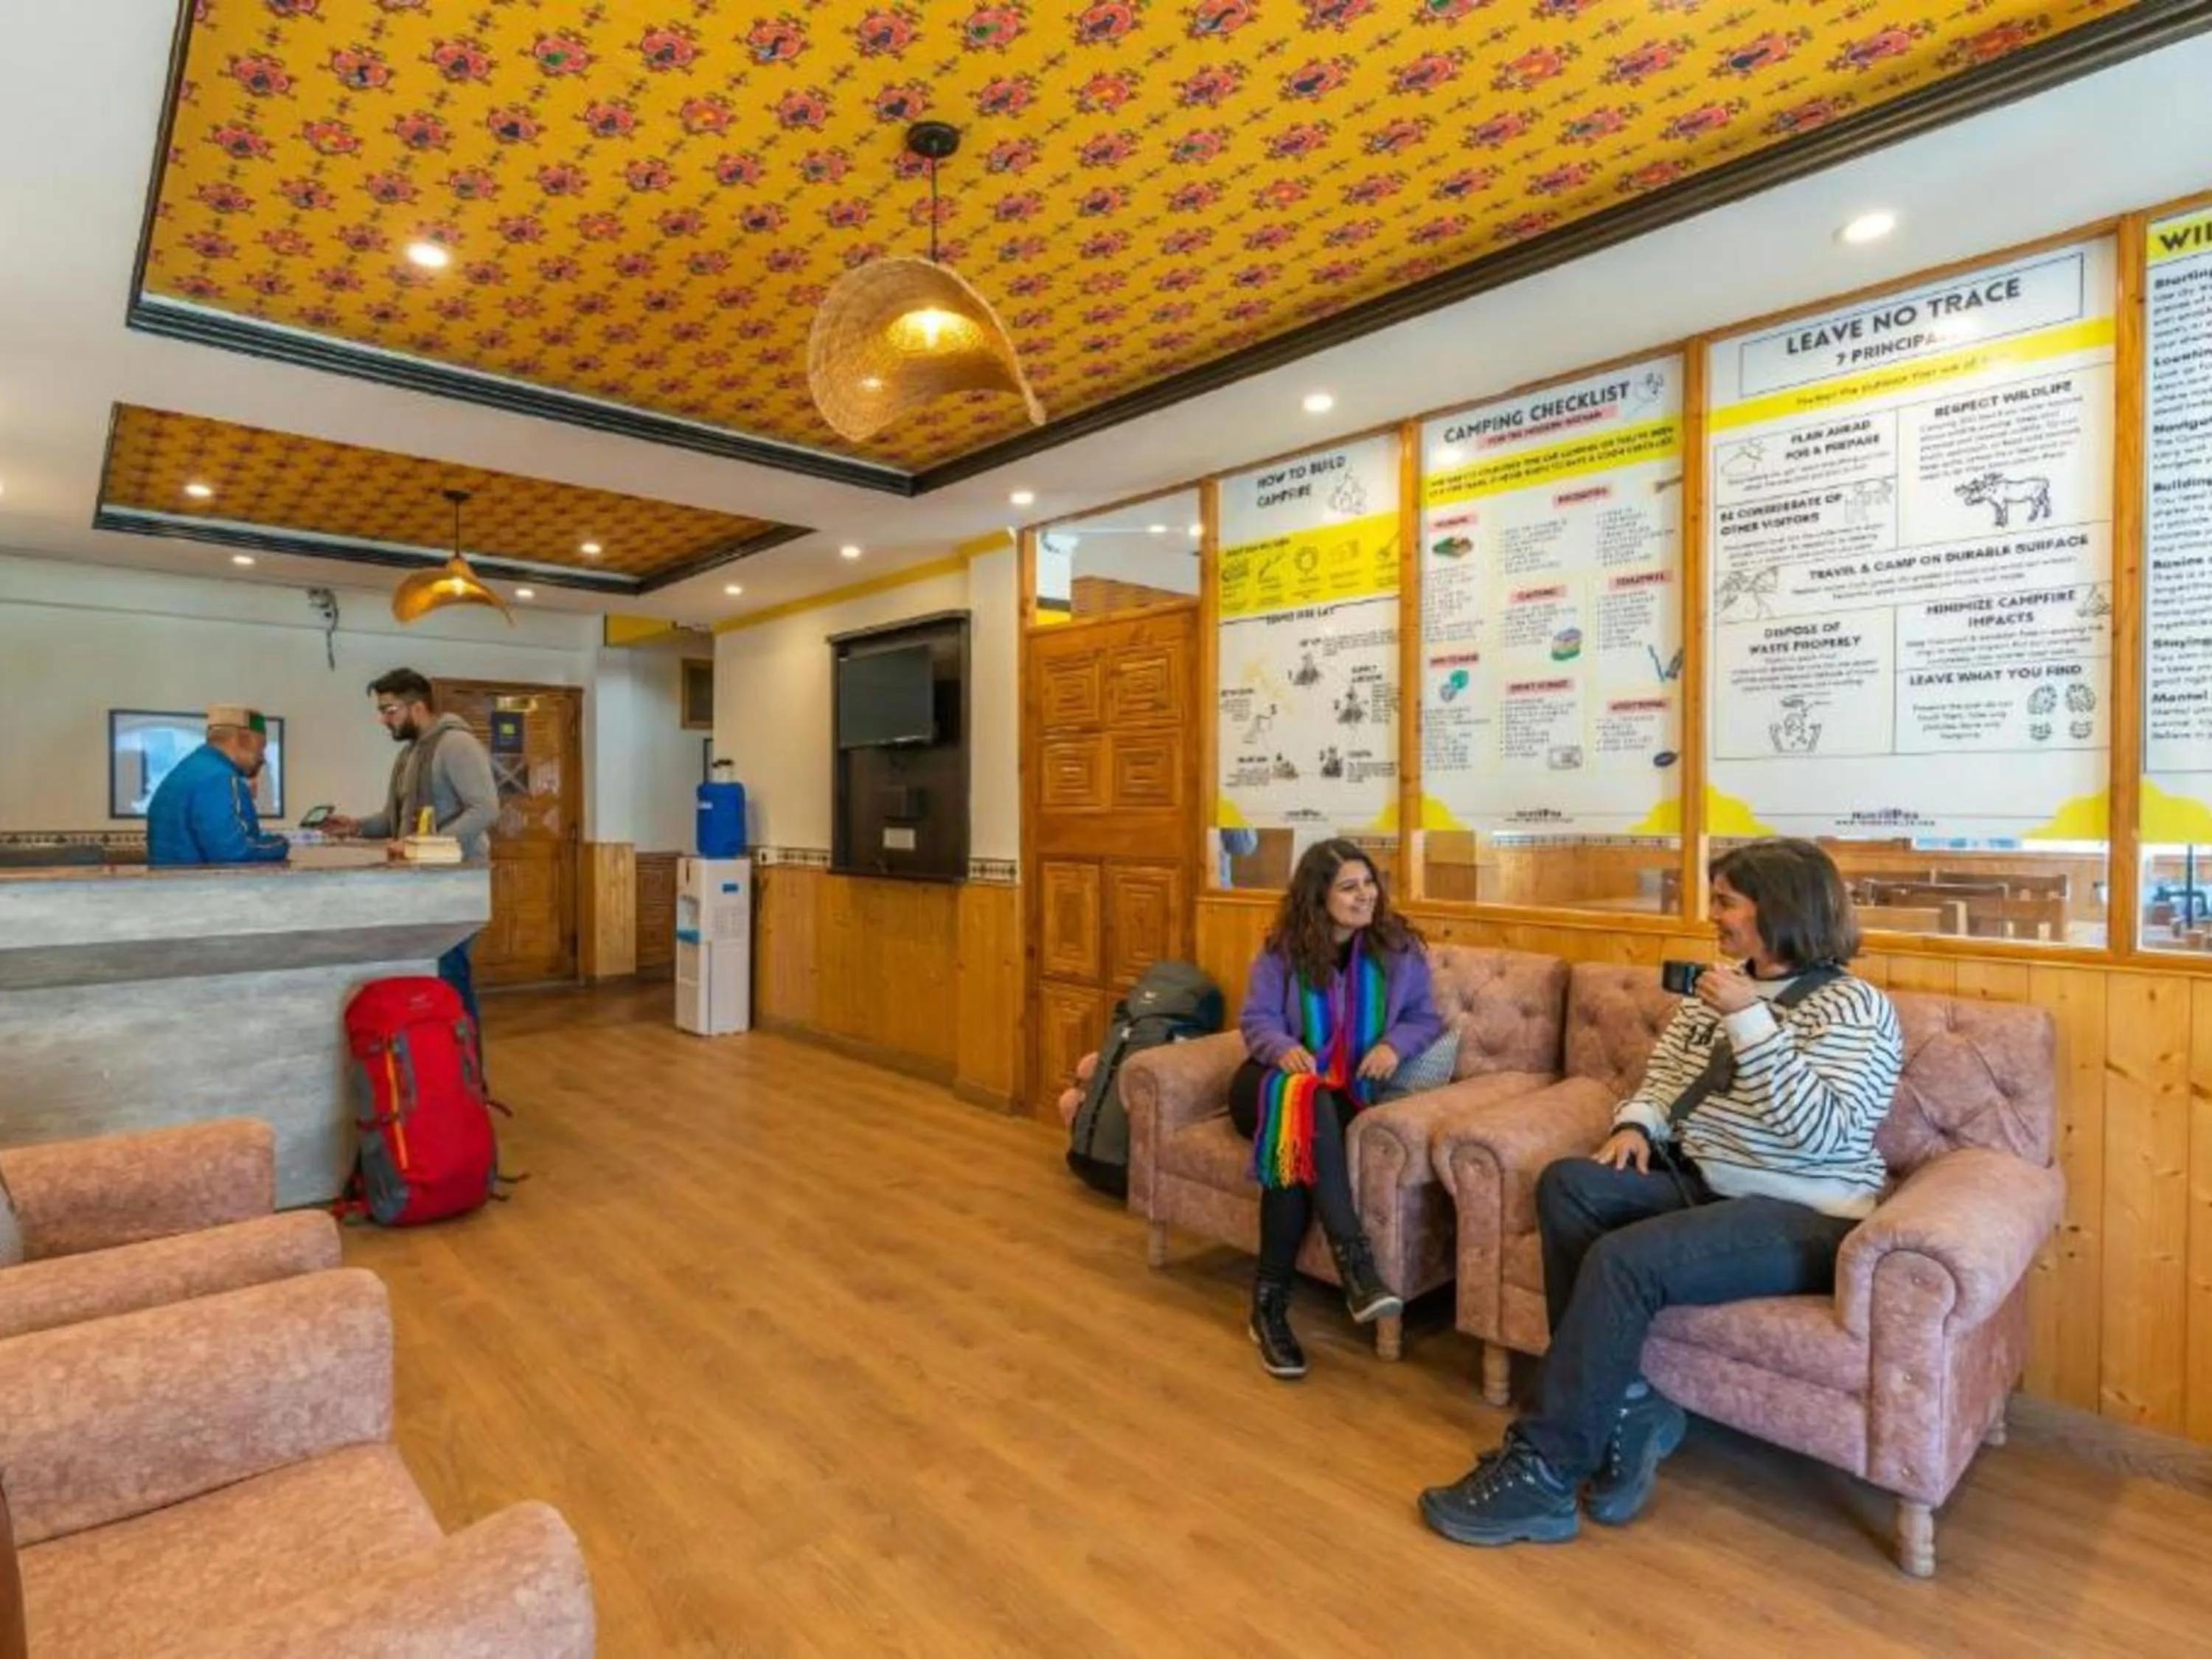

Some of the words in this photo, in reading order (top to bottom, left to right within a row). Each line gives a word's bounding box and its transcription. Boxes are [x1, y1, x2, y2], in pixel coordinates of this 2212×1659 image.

[1787, 318, 1863, 355] LEAVE
[1874, 306, 1916, 333] NO
[1927, 277, 2021, 319] TRACE
[1837, 352, 1846, 366] 7
[2154, 348, 2212, 366] Locatin
[1934, 395, 1999, 417] RESPECT
[2003, 380, 2073, 403] WILDLIFE
[1444, 409, 1524, 444] CAMPING
[1529, 380, 1631, 421] CHECKLIST
[1791, 430, 1823, 444] PLAN
[1826, 419, 1871, 438] AHEAD
[1825, 434, 1880, 454] PREPARE
[1257, 472, 1285, 490] HOW
[1290, 465, 1306, 479] TO
[1310, 456, 1346, 474] BUILD
[1257, 484, 1312, 508] CAMPFIRE
[1720, 510, 1734, 522] BE
[1737, 496, 1821, 518] CONSIDERATE
[1825, 492, 1843, 504] OF
[1720, 522, 1759, 535] OTHER
[1761, 512, 1820, 529] VISITORS
[1809, 564, 1857, 580] TRAVEL
[1874, 556, 1916, 572] CAMP
[1919, 553, 1941, 566] ON
[1945, 543, 2012, 563] DURABLE
[2015, 533, 2089, 554] SURFACE
[1926, 599, 1992, 615] MINIMIZE
[1998, 588, 2076, 609] CAMPFIRE
[1764, 624, 1818, 639] DISPOSE
[1823, 622, 1841, 633] OF
[1968, 611, 2034, 627] IMPACTS
[1749, 640, 1789, 655] WASTE
[1793, 636, 1862, 652] PROPERLY
[1910, 672, 1953, 686] LEAVE
[1957, 669, 2003, 683] WHAT
[2007, 666, 2042, 680] YOU
[2046, 664, 2082, 676] FIND
